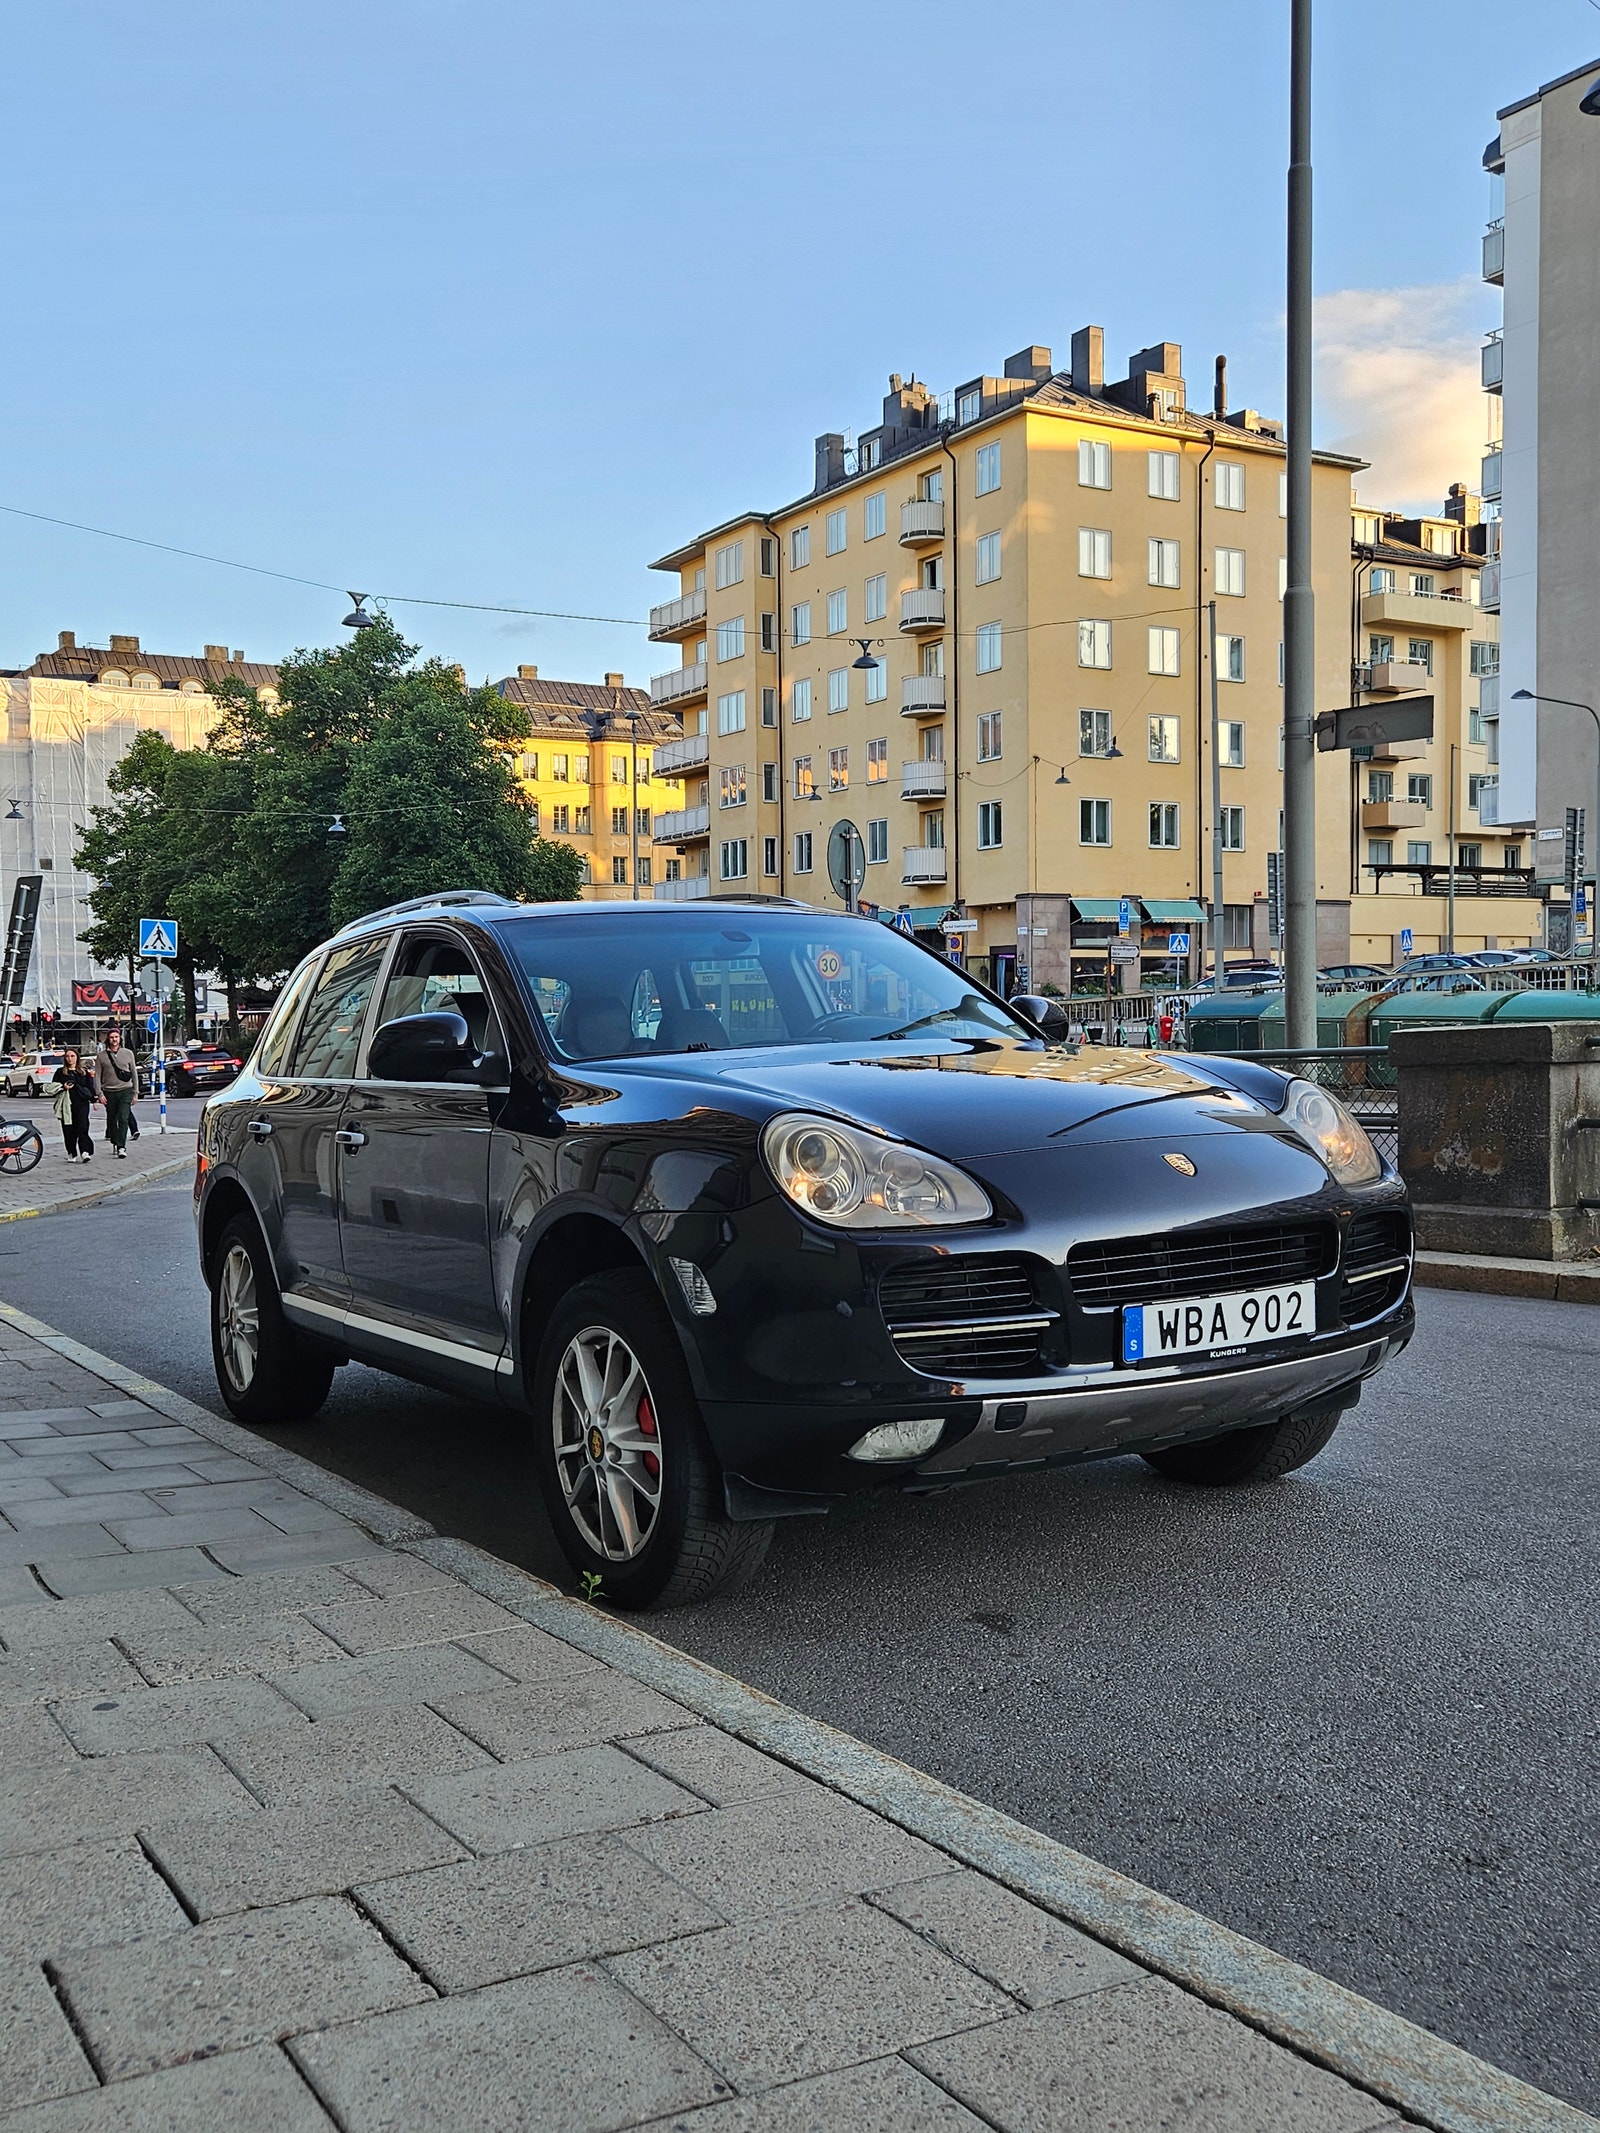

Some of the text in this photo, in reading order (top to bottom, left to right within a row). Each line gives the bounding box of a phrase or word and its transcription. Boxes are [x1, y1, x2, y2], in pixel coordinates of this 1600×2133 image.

[821, 958, 838, 973] 30
[75, 984, 111, 1003] ICA
[1157, 1291, 1303, 1350] WBA 902
[1130, 1339, 1138, 1352] S
[1210, 1347, 1247, 1359] KUNGERS
